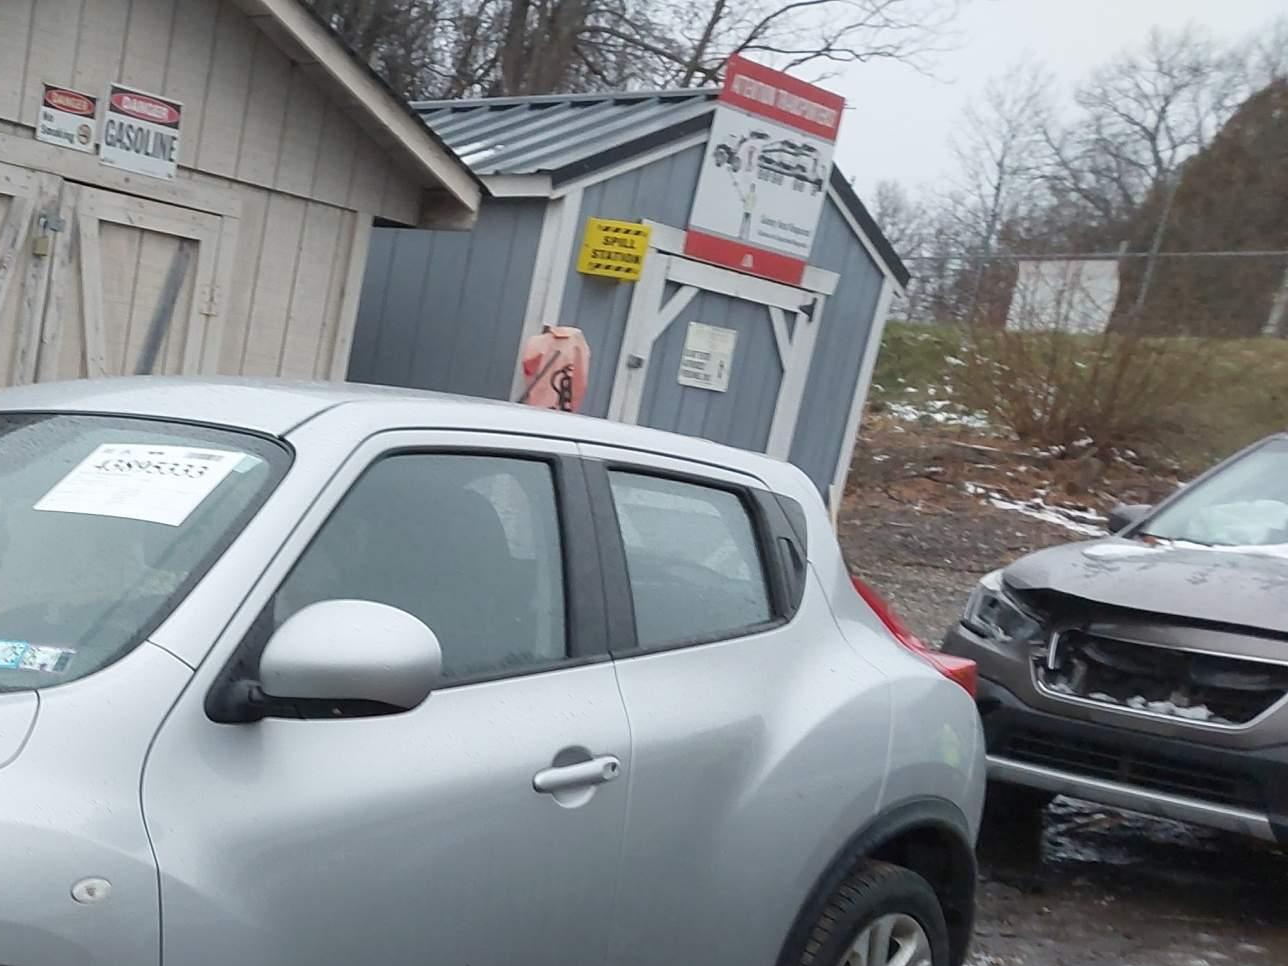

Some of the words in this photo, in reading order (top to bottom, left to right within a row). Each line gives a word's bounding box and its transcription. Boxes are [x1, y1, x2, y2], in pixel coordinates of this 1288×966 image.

[105, 119, 177, 162] GASOLINE
[603, 236, 636, 249] SPILL
[591, 248, 640, 265] STATION
